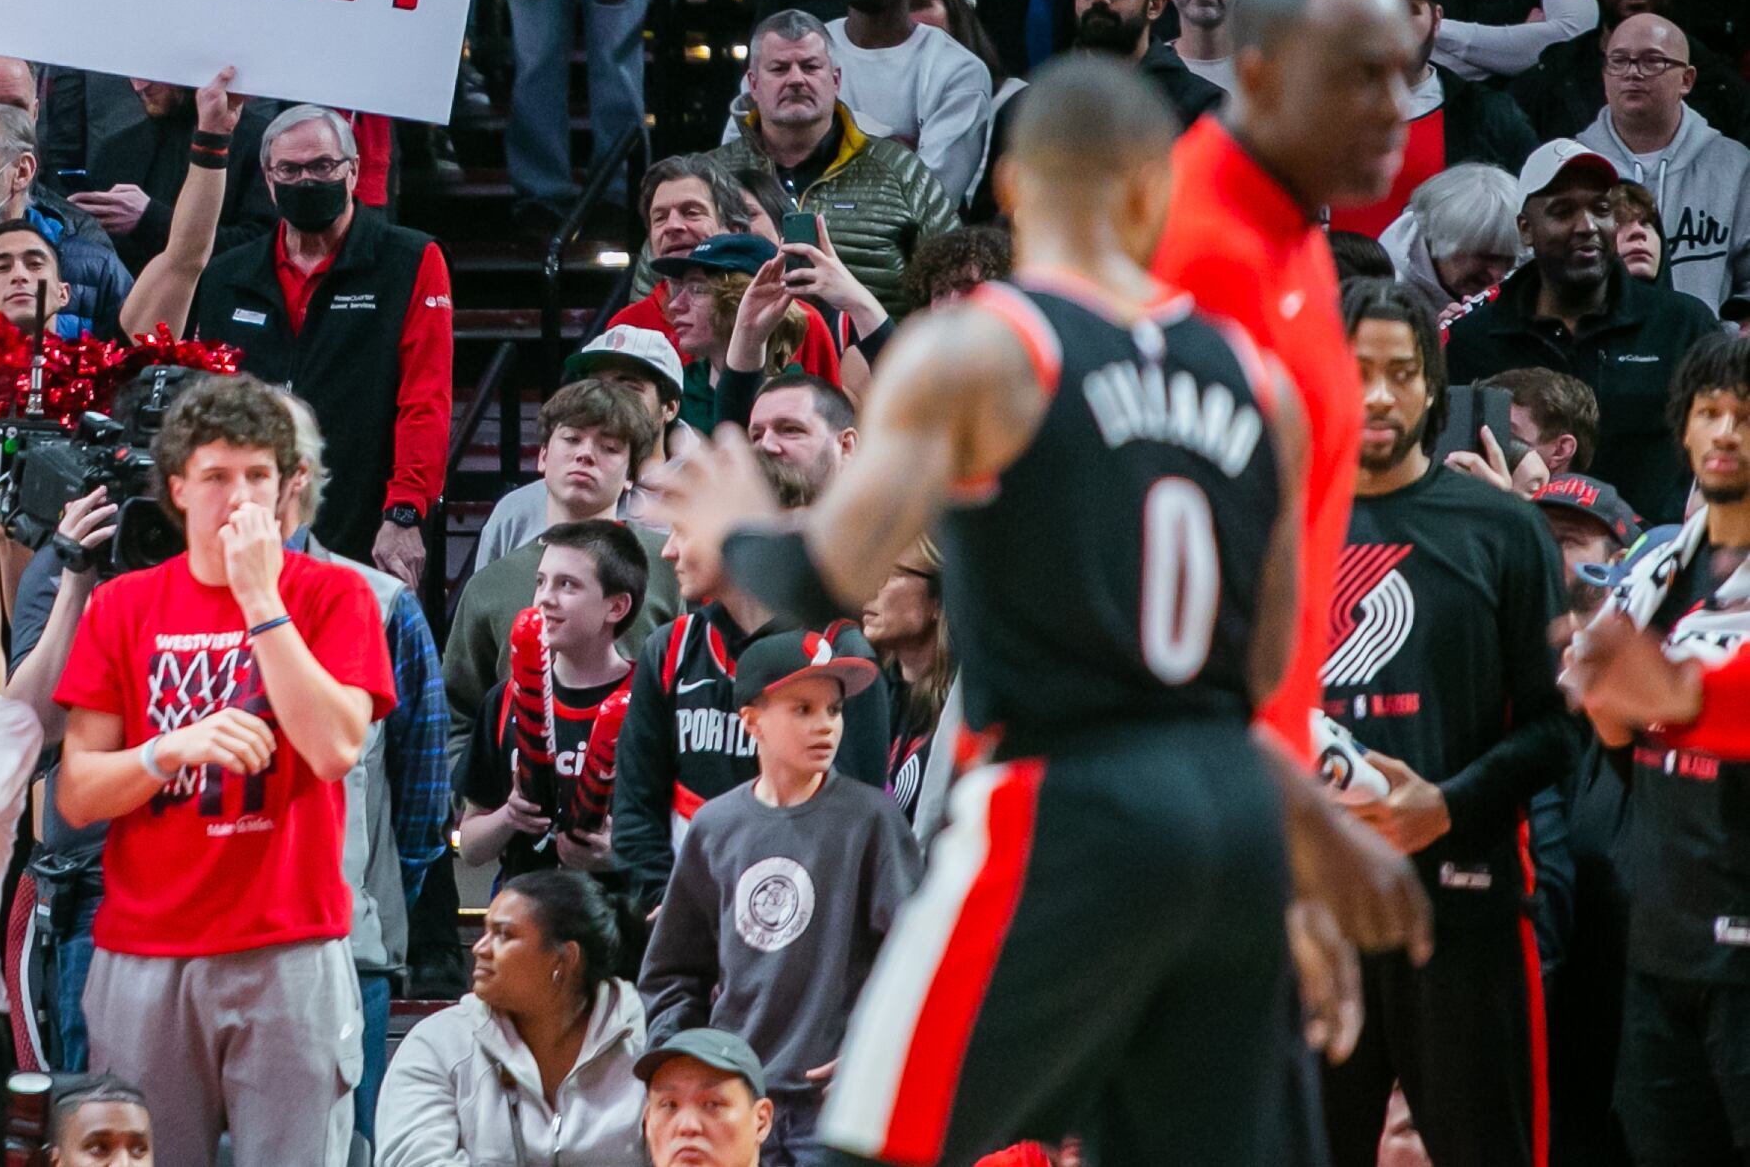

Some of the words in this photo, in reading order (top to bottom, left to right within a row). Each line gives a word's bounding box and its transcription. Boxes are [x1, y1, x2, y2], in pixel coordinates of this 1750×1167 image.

[1668, 207, 1729, 256] Air
[1138, 475, 1222, 687] 0
[156, 630, 245, 652] WESTVIEW
[676, 707, 758, 757] PORTL
